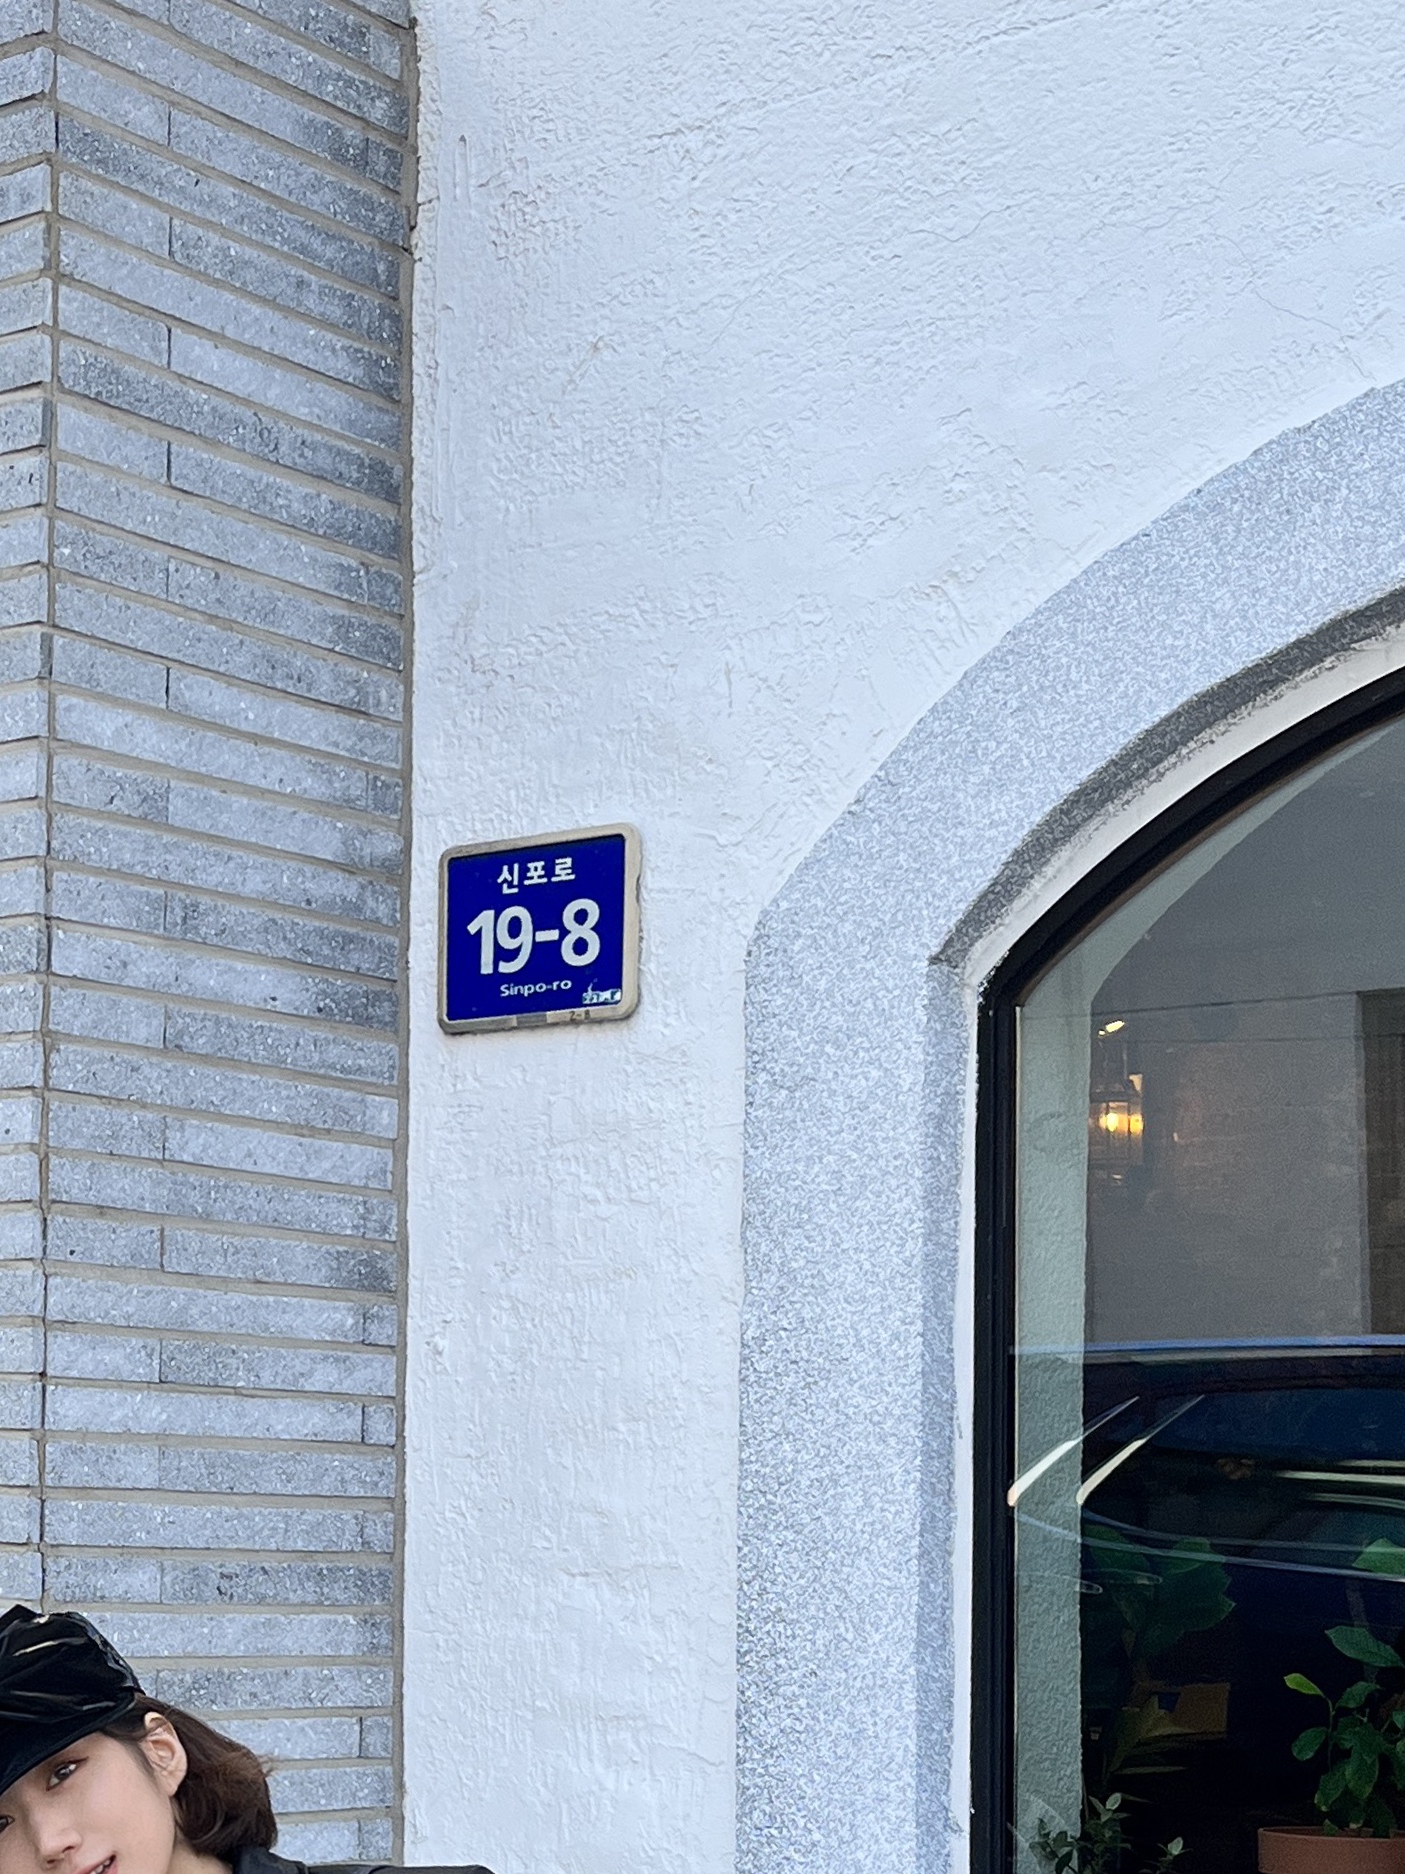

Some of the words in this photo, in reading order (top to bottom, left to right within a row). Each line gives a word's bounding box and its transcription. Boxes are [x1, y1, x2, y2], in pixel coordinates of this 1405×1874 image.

[497, 857, 576, 895] 신포로
[467, 898, 601, 975] 19-8
[500, 979, 573, 998] Sinpo-ro
